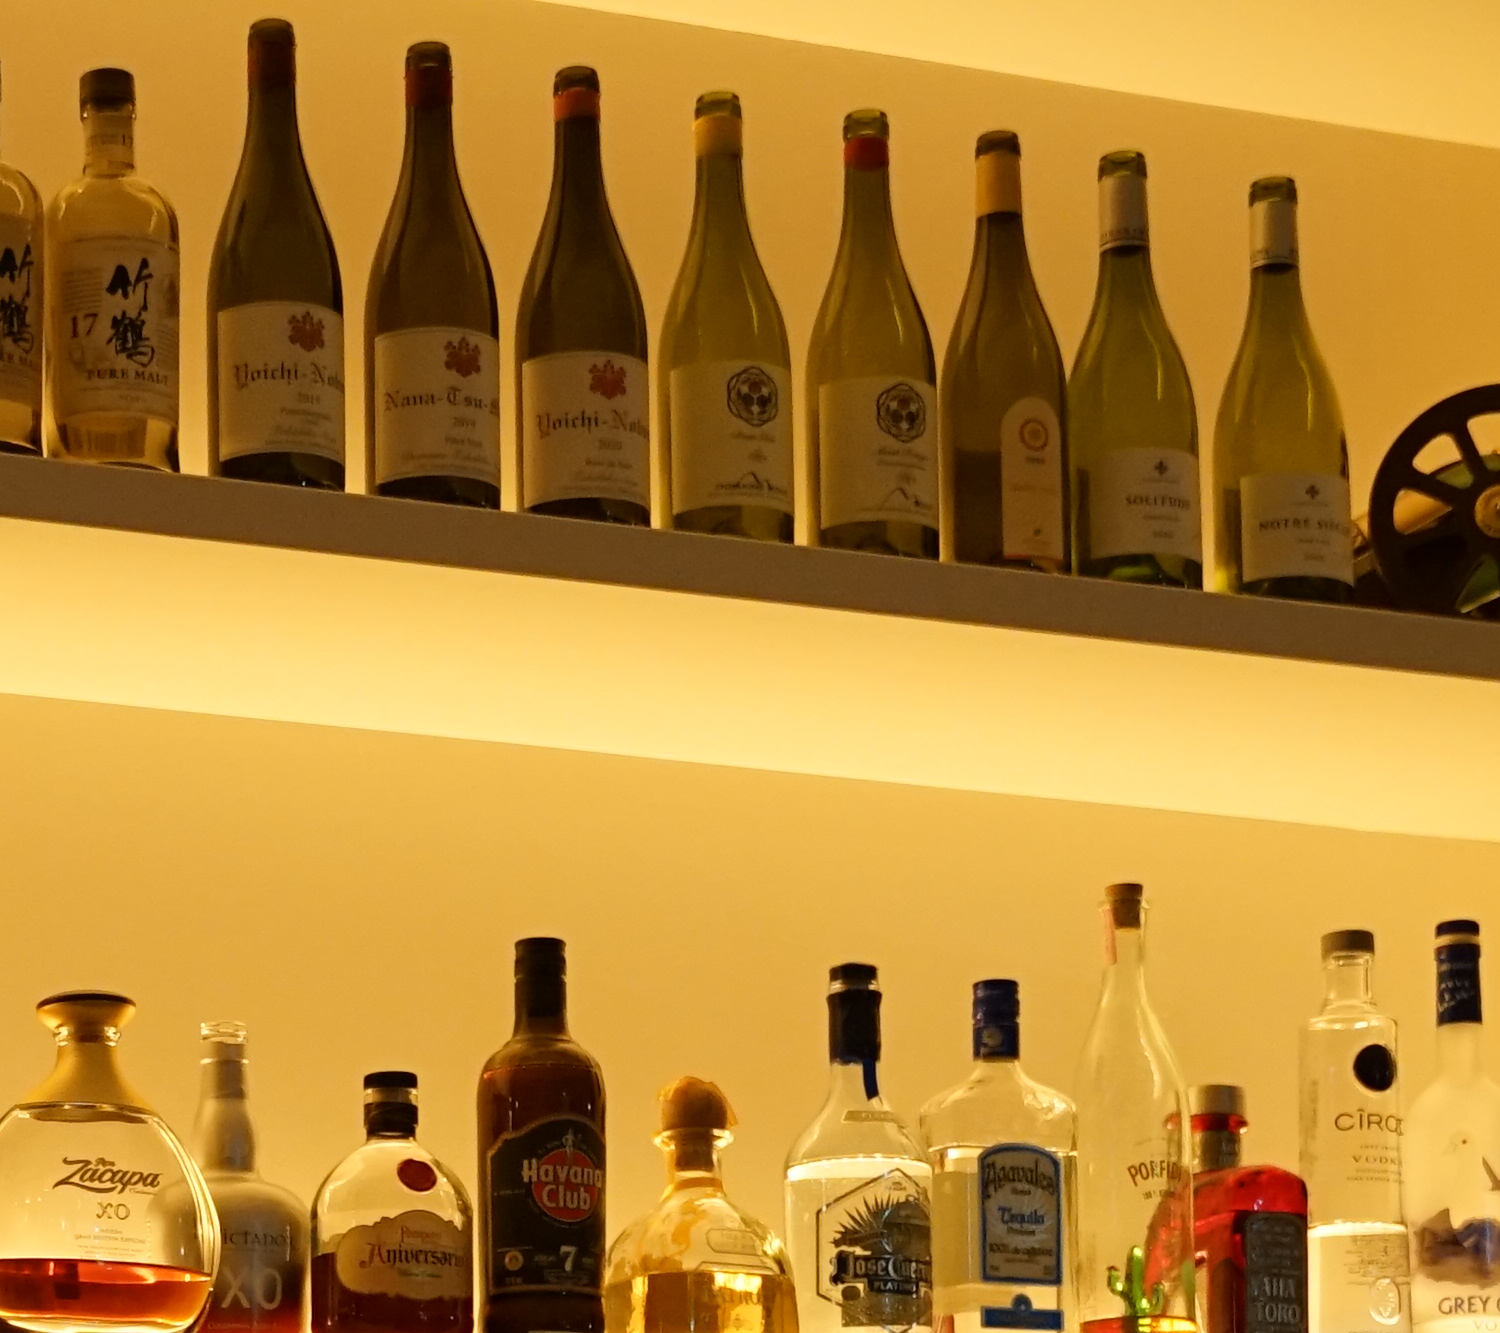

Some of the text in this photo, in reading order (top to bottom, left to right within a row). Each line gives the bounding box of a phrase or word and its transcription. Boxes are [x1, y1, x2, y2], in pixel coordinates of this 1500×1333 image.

[105, 257, 152, 367] 竹鶴
[69, 312, 96, 340] 17
[53, 1157, 163, 1195] Zacapa
[521, 1158, 602, 1187] Havana
[95, 1202, 130, 1222] XO
[541, 1186, 593, 1212] Club
[996, 1204, 1046, 1226] Tequila
[222, 1226, 300, 1249] ICTADO
[558, 1245, 578, 1273] 7
[221, 1268, 284, 1309] XO
[1254, 1302, 1299, 1326] TORO
[1437, 1296, 1490, 1318] GREY
